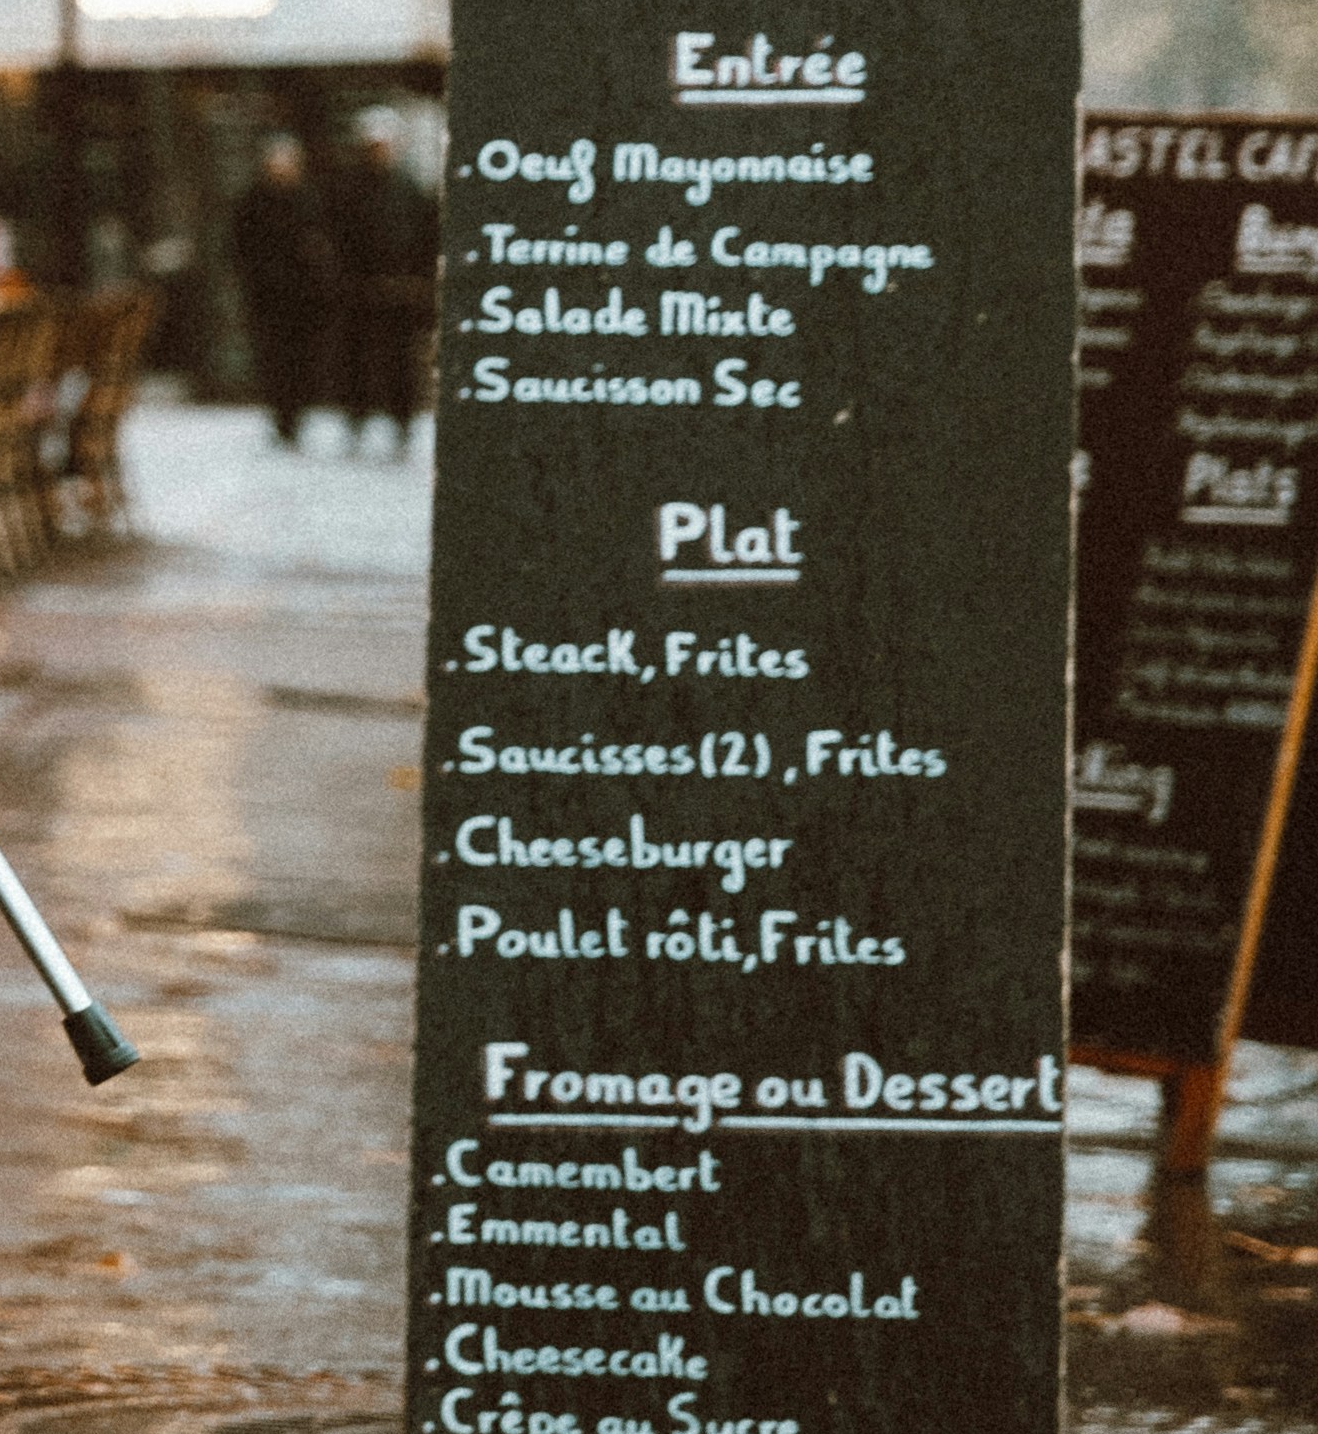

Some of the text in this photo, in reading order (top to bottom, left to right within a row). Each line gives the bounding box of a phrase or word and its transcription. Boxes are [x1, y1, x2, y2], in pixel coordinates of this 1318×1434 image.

[673, 31, 866, 87] Entrée
[477, 138, 873, 206] Oeuf Mayonnaise
[482, 223, 934, 294] Terrine de Campagne
[476, 285, 795, 337] Salade Mixte
[473, 356, 801, 408] Saucisson Sec
[658, 501, 803, 564] Plat
[665, 631, 809, 679] Frites
[455, 813, 792, 894] Cheeseburger
[456, 904, 628, 959] Poulet
[484, 1041, 1064, 1134] Fromage ou Dessert
[445, 1138, 720, 1192] Camembert
[447, 1202, 685, 1251] Emmental
[446, 1265, 919, 1319] Mousse au Chocolat
